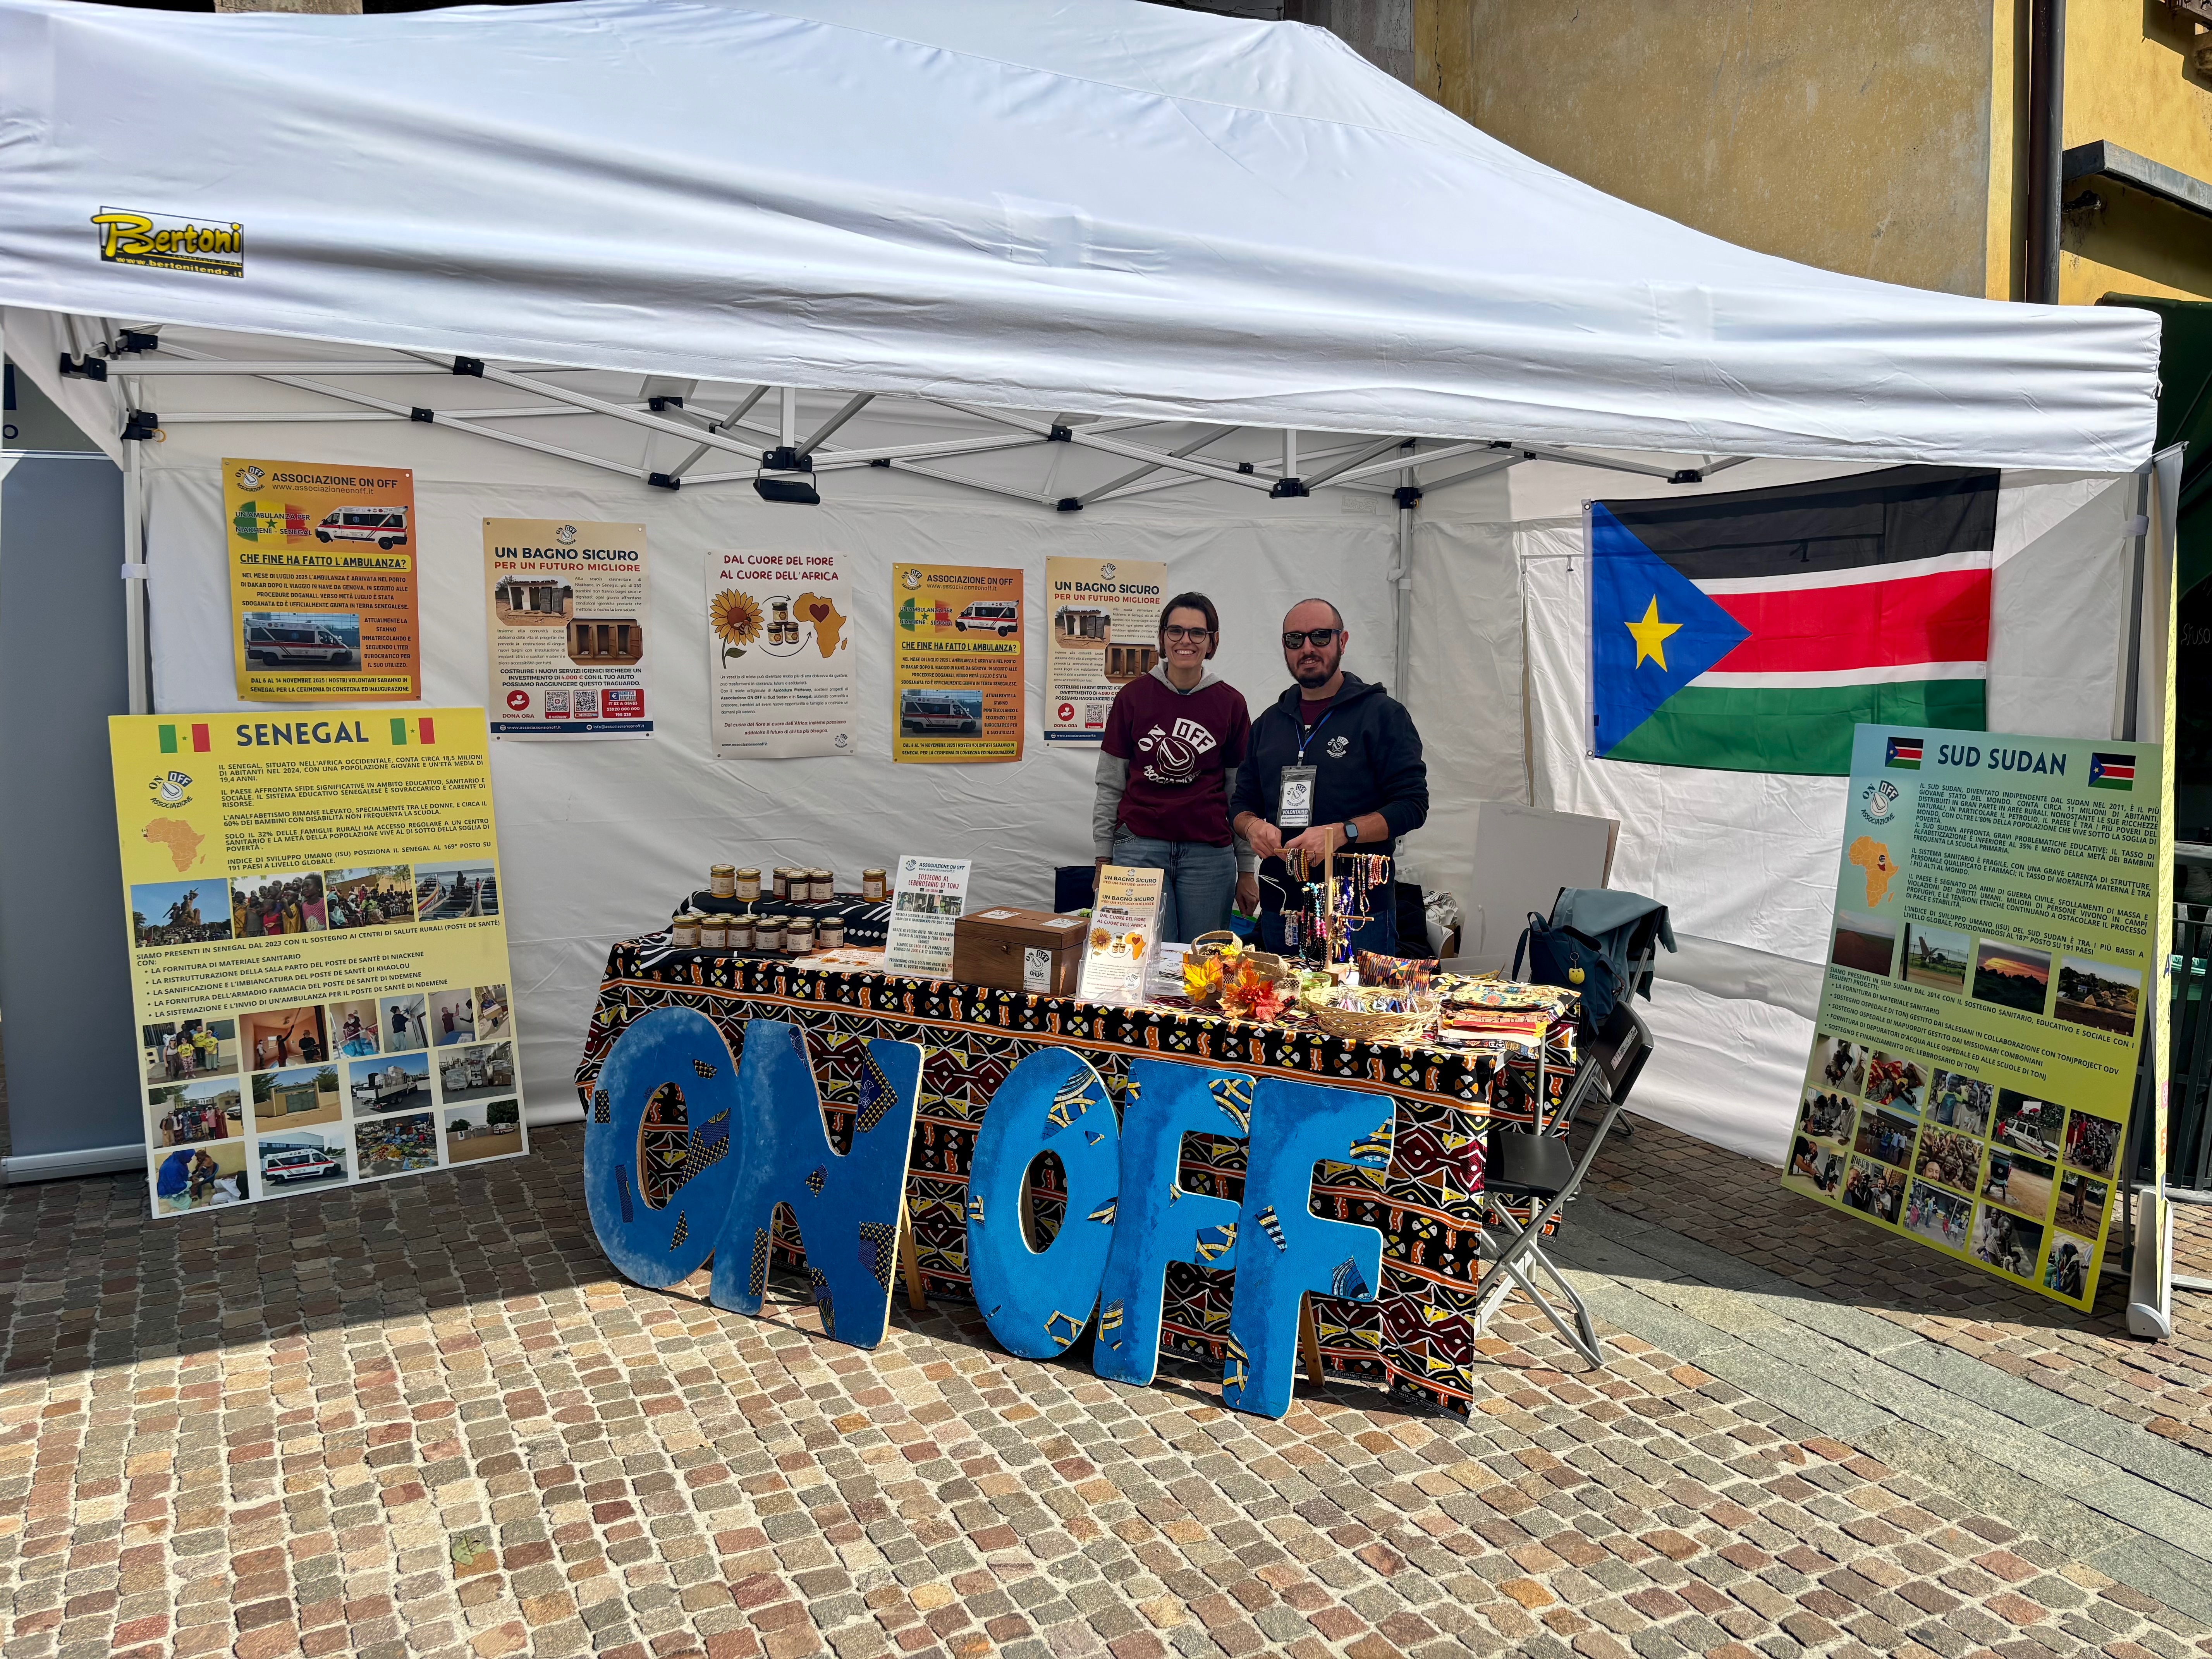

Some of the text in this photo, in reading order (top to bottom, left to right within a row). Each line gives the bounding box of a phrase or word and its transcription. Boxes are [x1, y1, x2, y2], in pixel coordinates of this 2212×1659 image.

[91, 213, 241, 257] Bertoni
[116, 257, 242, 278] www.bertonitende.it
[235, 466, 265, 477] ON OFF
[272, 472, 398, 489] ASSOCIAZIONE ON OFF
[272, 485, 374, 495] www.associazioneonoff.it
[235, 511, 296, 520] UN'AMBULANZA
[235, 526, 272, 535] NIAKHENE
[280, 527, 312, 537] SENEGAL
[240, 553, 406, 569] CHE FINE HA FATTO L'AMBULANZA?
[495, 547, 639, 561] UN BAGNO SICURO
[724, 555, 834, 566] DAL CUORE DEL FIORE
[588, 563, 640, 572] MIGLIORE
[720, 570, 839, 580] AL CUORE DELL'AFRICA
[927, 575, 986, 584] ASSOCIAZIONE
[1055, 581, 1160, 595] UN BAGNO SICURO
[901, 641, 1016, 653] CHE FINE HA FATTO L'AMBULANZA?
[236, 721, 369, 746] SENEGAL
[1138, 721, 1214, 751] ON OFF
[345, 758, 393, 766] OCCIDENTALE,
[1937, 744, 2067, 776] SUD SUDAN
[149, 771, 192, 790] ON OFF
[1862, 781, 1898, 800] ON OFF
[150, 796, 193, 809] ASSOCIAZIONE
[1966, 788, 1999, 796] DIVENTATO
[2002, 792, 2047, 802] INDIPENDENTE
[2109, 804, 2126, 812] 2011,
[1861, 812, 1895, 826] ASSOCIAZIONE
[163, 963, 207, 972] FORNITURA
[219, 957, 260, 967] MATERIALE
[262, 953, 301, 962] SANITARIO
[1026, 951, 1049, 962] ON OFF
[1834, 993, 1860, 1005] SOSTEGNO
[1861, 1000, 1887, 1012] OSPEDALE
[1896, 1010, 1909, 1019] TONJ
[1910, 1013, 1932, 1025] GESTITO
[1945, 1023, 1974, 1036] SALESIANI
[1983, 1033, 2040, 1054] COLLABORAZIONE
[2041, 1049, 2056, 1058] CON
[2057, 1053, 2102, 1071] TONJPROJECT
[2104, 1065, 2119, 1075] ODV
